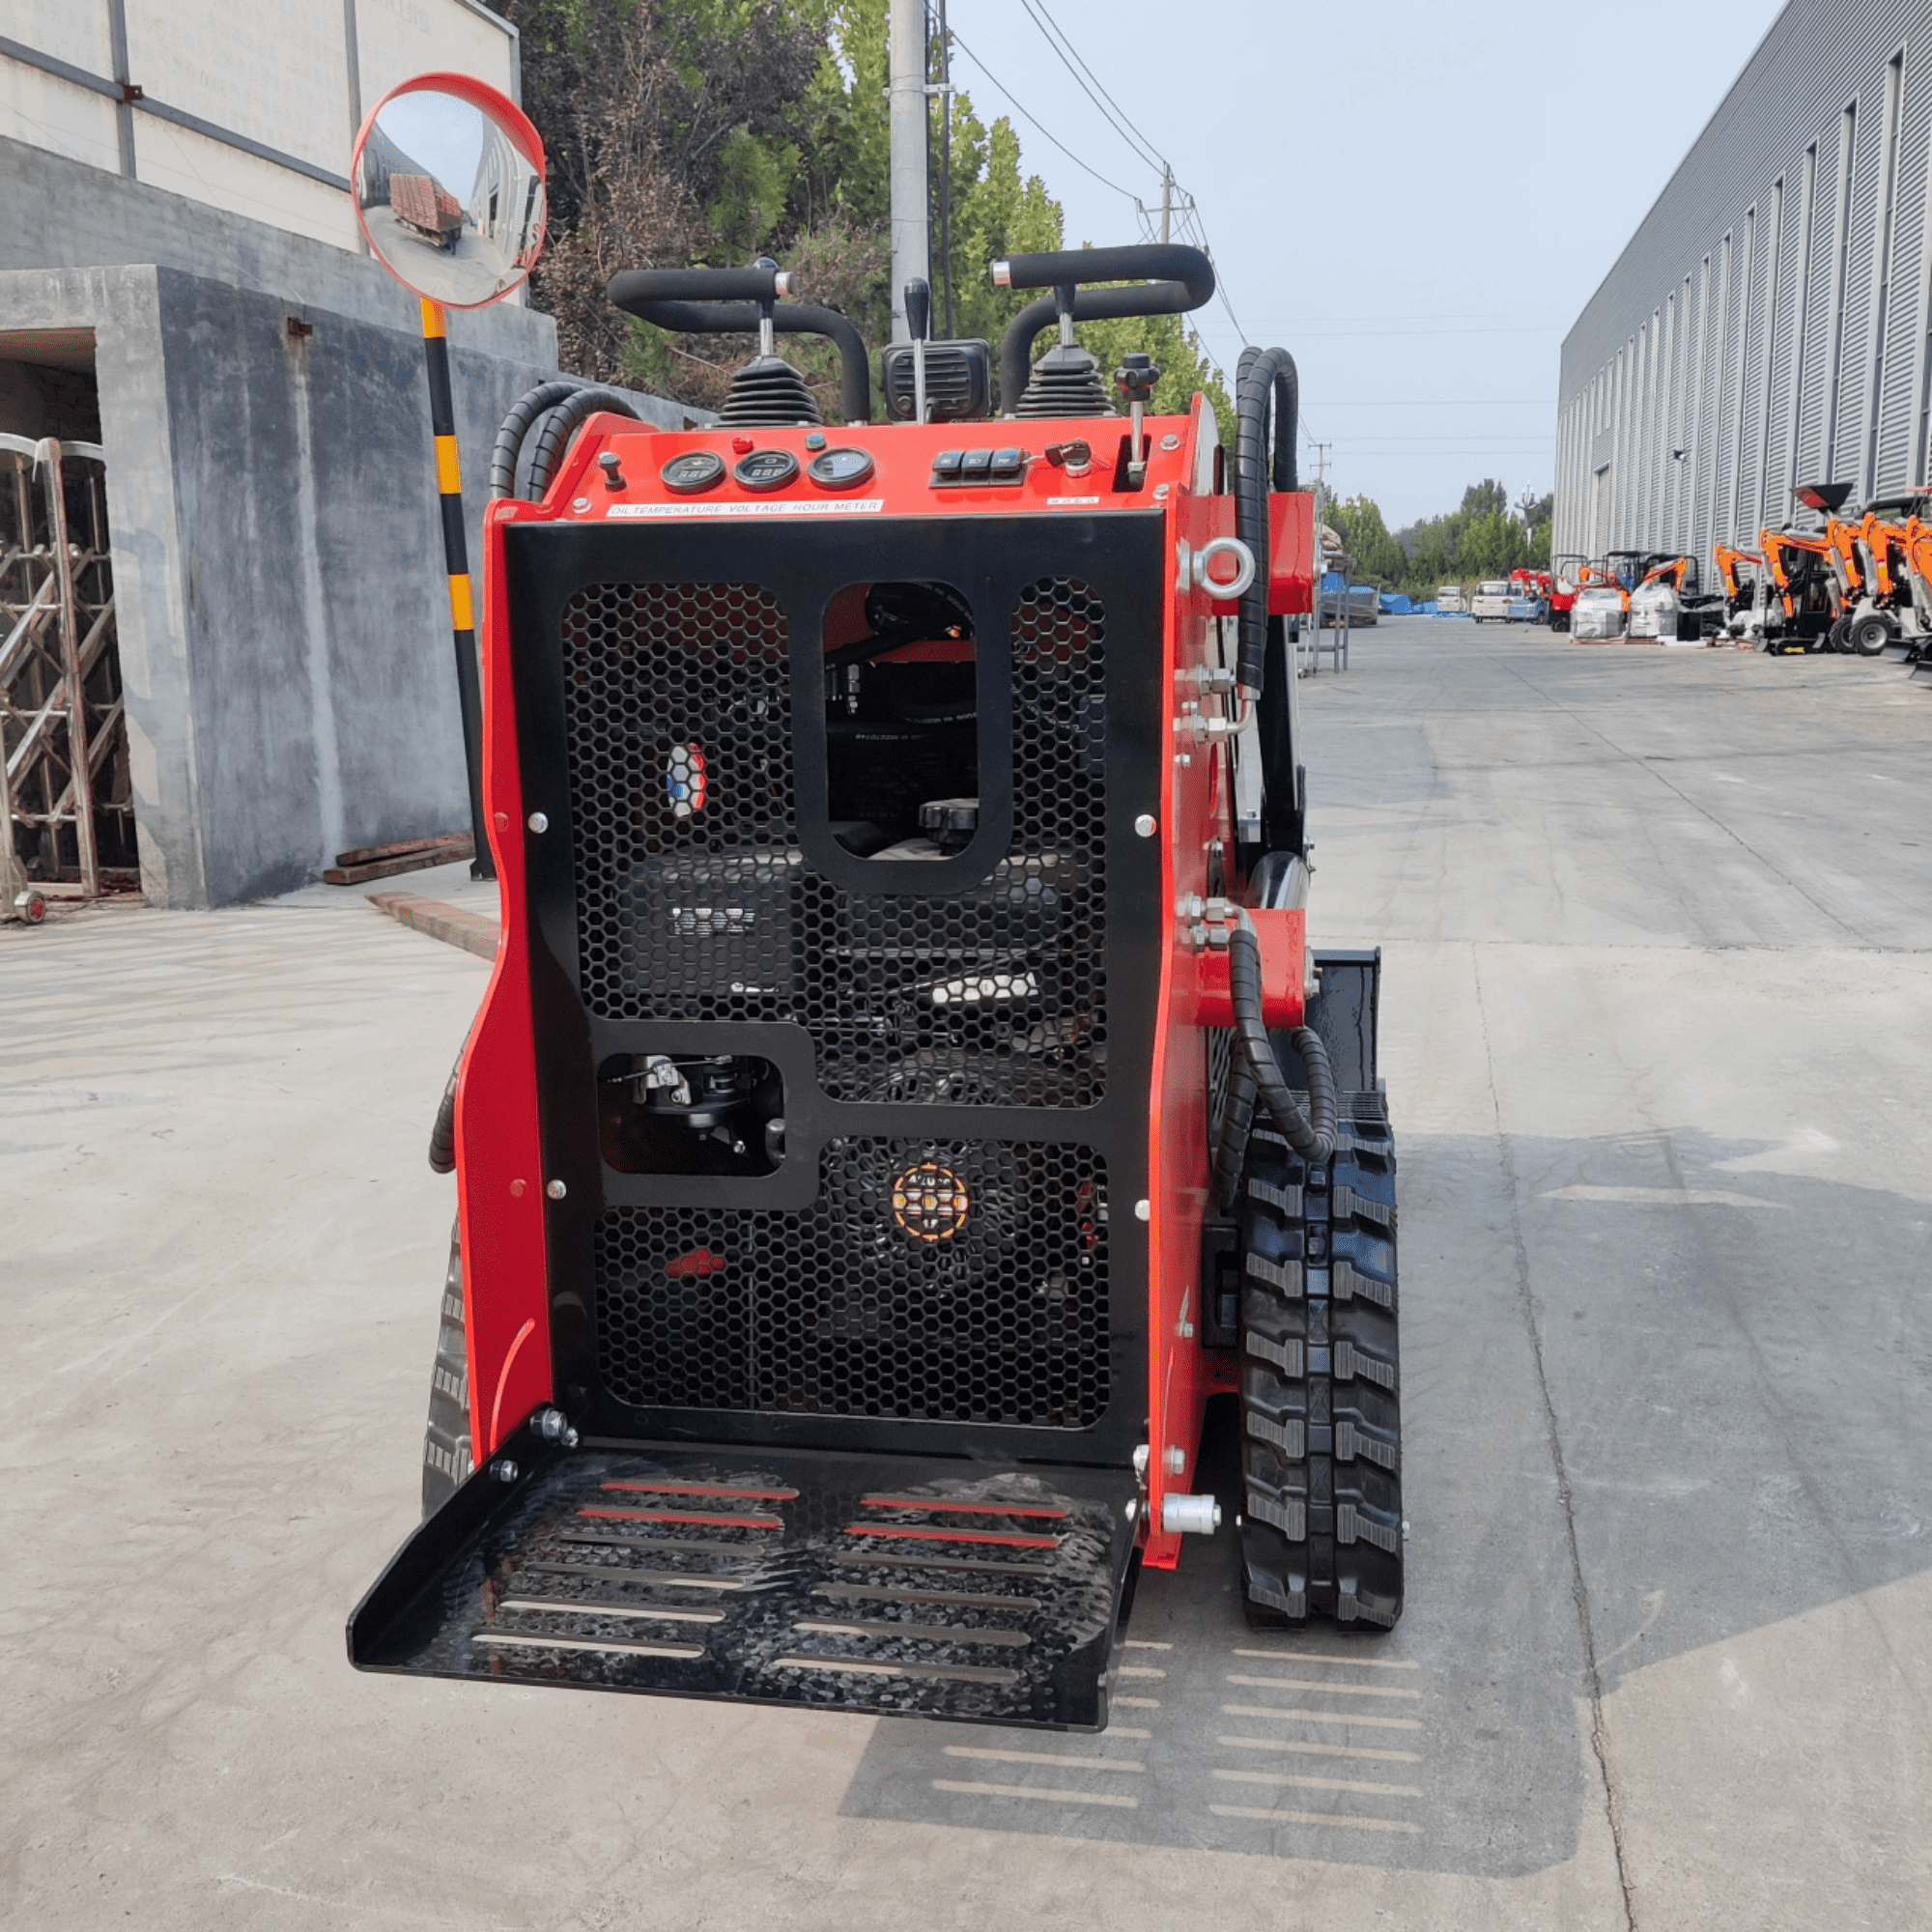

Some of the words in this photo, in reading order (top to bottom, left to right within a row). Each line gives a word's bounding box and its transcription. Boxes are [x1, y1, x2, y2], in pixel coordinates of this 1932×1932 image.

[634, 504, 723, 515] TEMPERATURE
[793, 502, 829, 512] HOUR
[834, 500, 878, 511] METER
